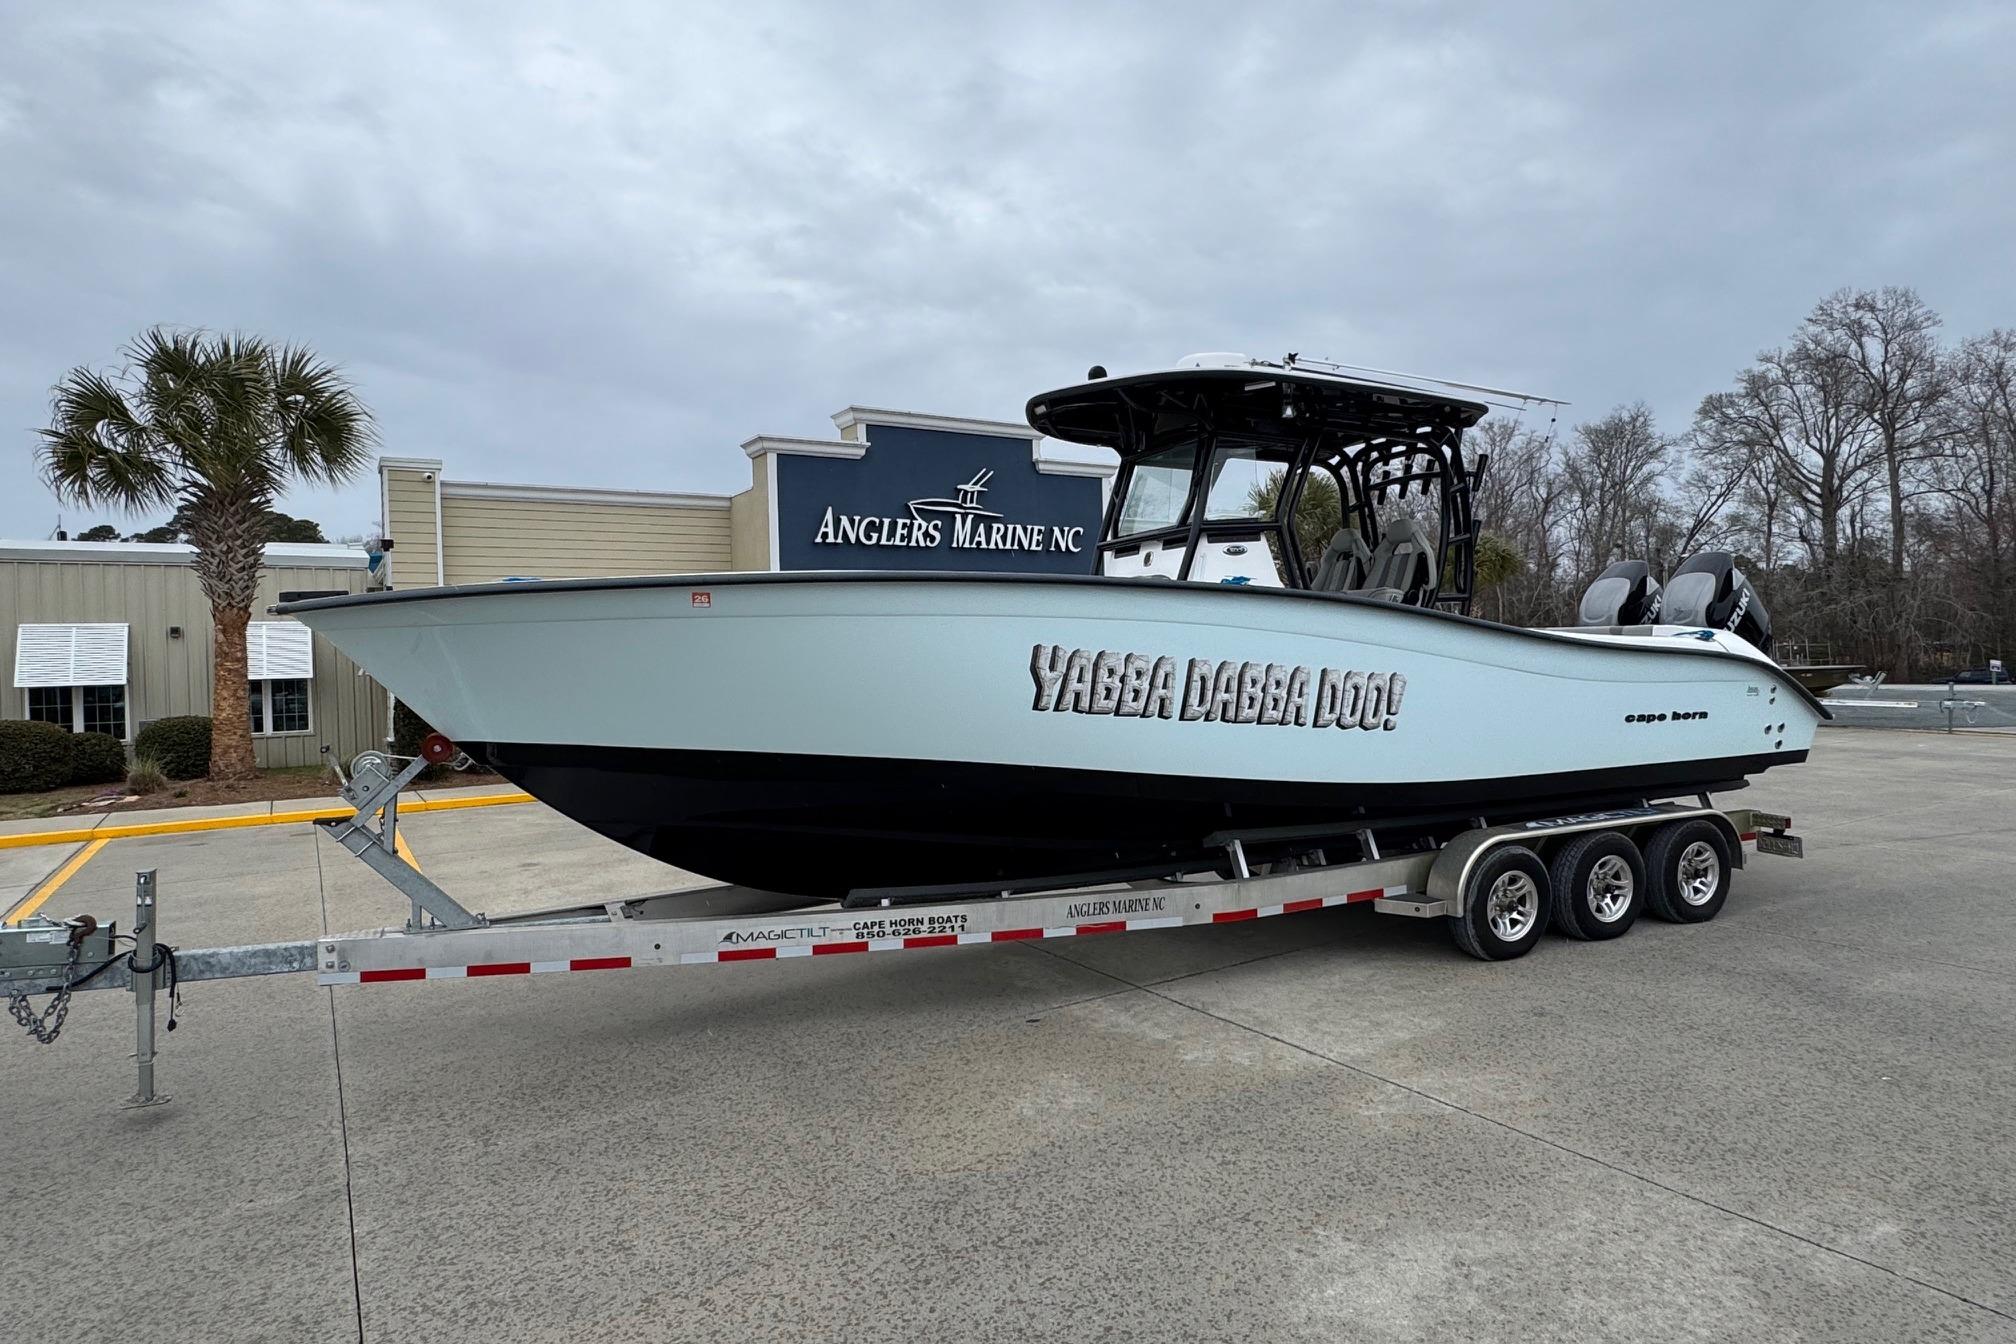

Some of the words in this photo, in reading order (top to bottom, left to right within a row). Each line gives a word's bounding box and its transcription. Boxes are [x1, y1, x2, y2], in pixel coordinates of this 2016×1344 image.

[814, 506, 942, 548] ANGLERS
[951, 514, 1045, 551] MARINE
[1049, 526, 1084, 553] NC
[694, 595, 709, 603] 26
[1723, 588, 1750, 632] UZUKI
[1030, 643, 1177, 719] YABBA
[1179, 657, 1311, 727] DABBA
[1312, 666, 1408, 732] DOO!
[1671, 711, 1708, 721] horn
[1066, 900, 1110, 919] ANGLERS
[1112, 897, 1150, 915] MARINE
[1151, 896, 1166, 911] NC
[853, 920, 886, 931] CAPE
[889, 917, 924, 928] HORN
[928, 914, 968, 925] BOATS
[735, 926, 830, 944] MAGICTILT
[855, 924, 966, 940] 850-626-2211
